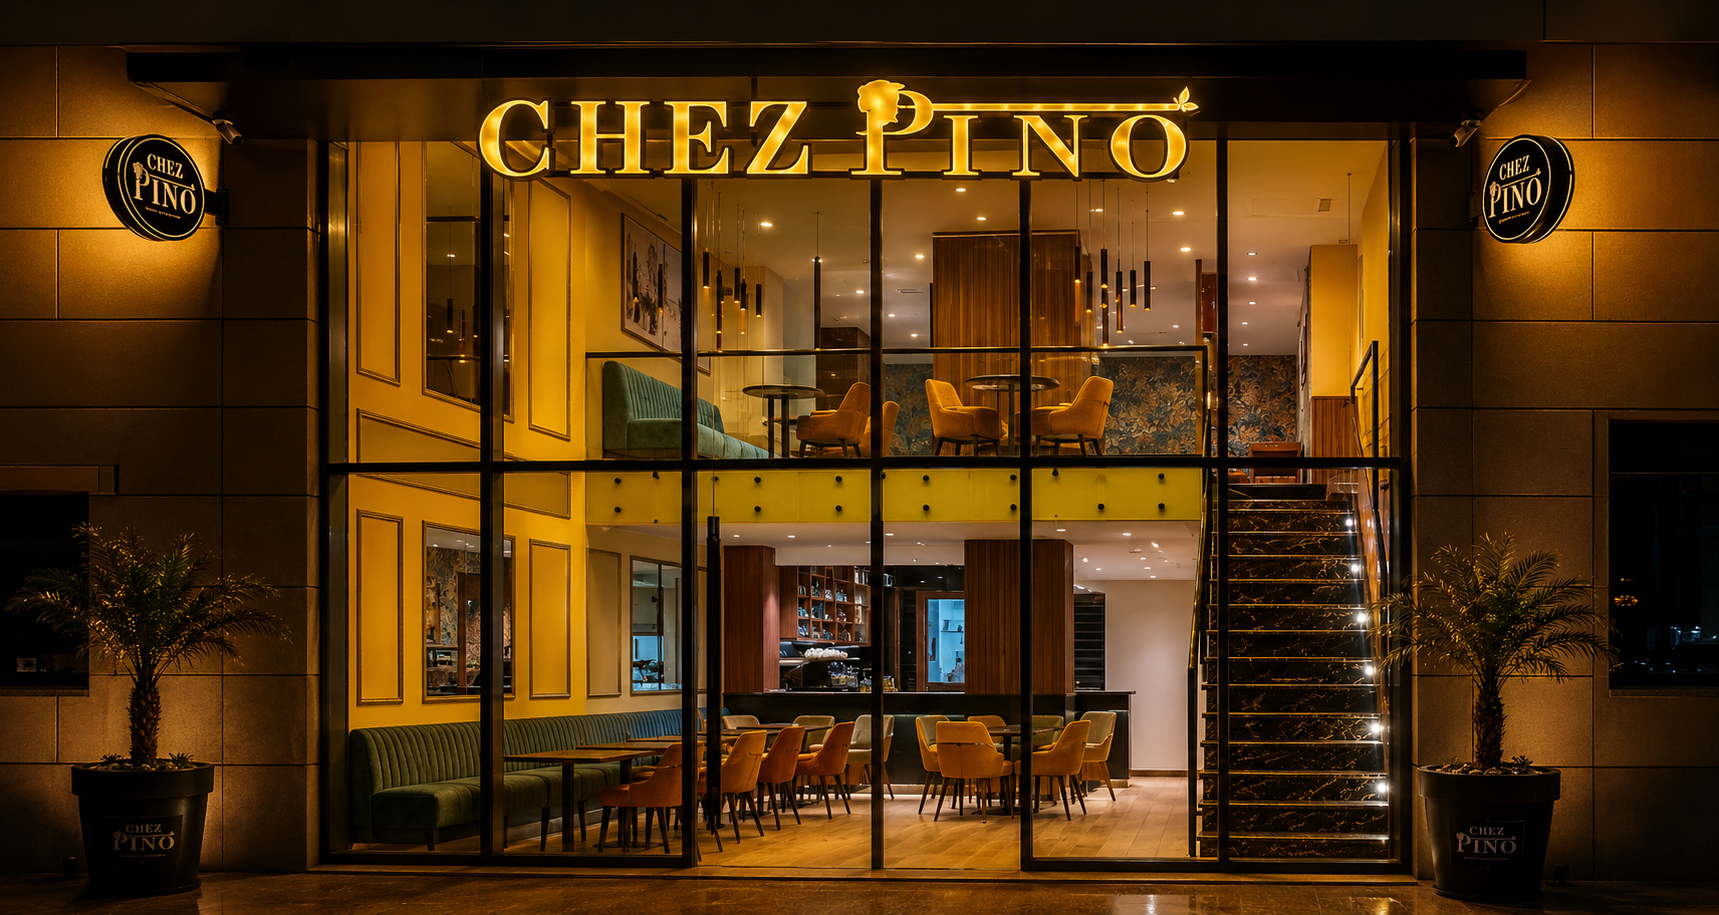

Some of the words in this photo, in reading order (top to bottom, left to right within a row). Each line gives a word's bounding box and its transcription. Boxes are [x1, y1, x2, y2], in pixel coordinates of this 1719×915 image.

[479, 99, 811, 178] CHEZ
[851, 79, 1189, 180] PINO
[147, 153, 184, 179] CHEZ
[1499, 154, 1530, 181] CHEZ
[132, 161, 197, 214] PINO
[1488, 177, 1542, 219] PINO
[112, 831, 175, 851] PINO
[125, 823, 162, 834] CHEZ
[1469, 825, 1505, 836] CHEZ
[1456, 832, 1517, 854] PINO
